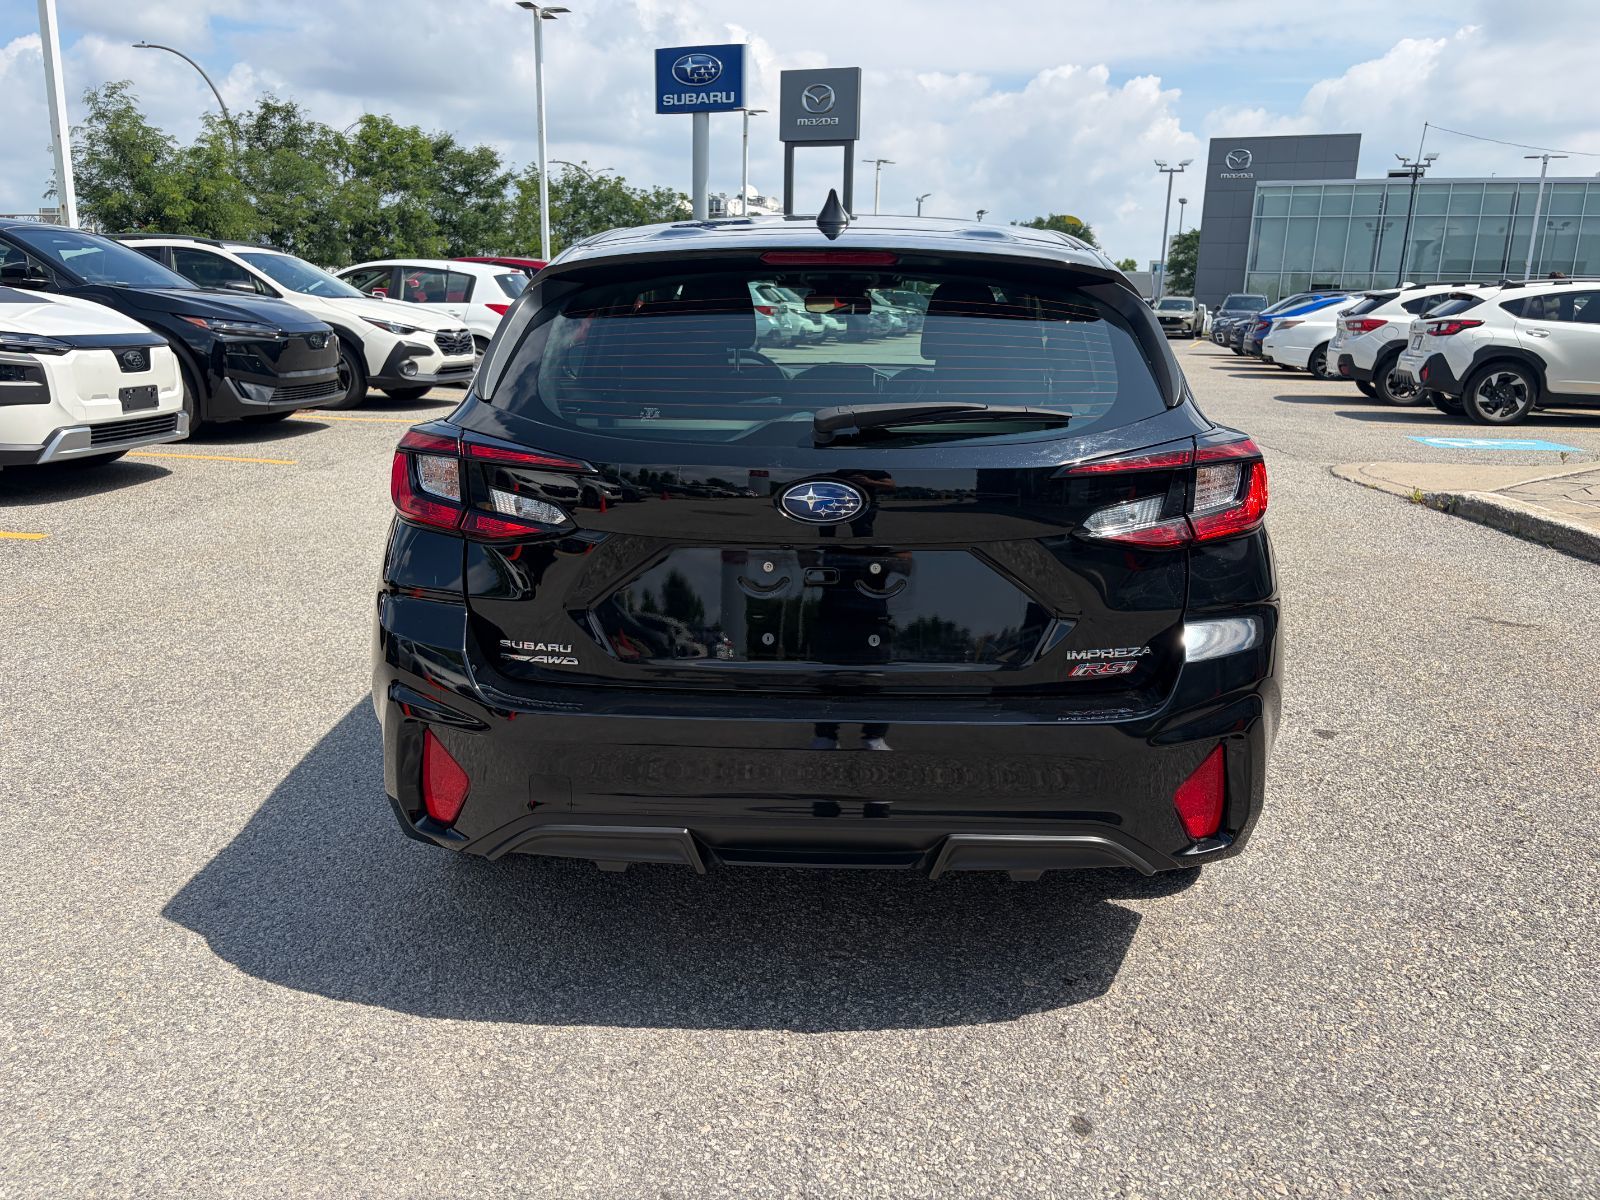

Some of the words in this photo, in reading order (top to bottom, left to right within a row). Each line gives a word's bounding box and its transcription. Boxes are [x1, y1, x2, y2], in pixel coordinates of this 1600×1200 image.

[662, 91, 735, 107] SUBARU
[796, 117, 839, 126] mazda
[499, 639, 573, 653] SUBARU
[528, 655, 579, 665] AWD
[1066, 646, 1153, 661] IMPREZA
